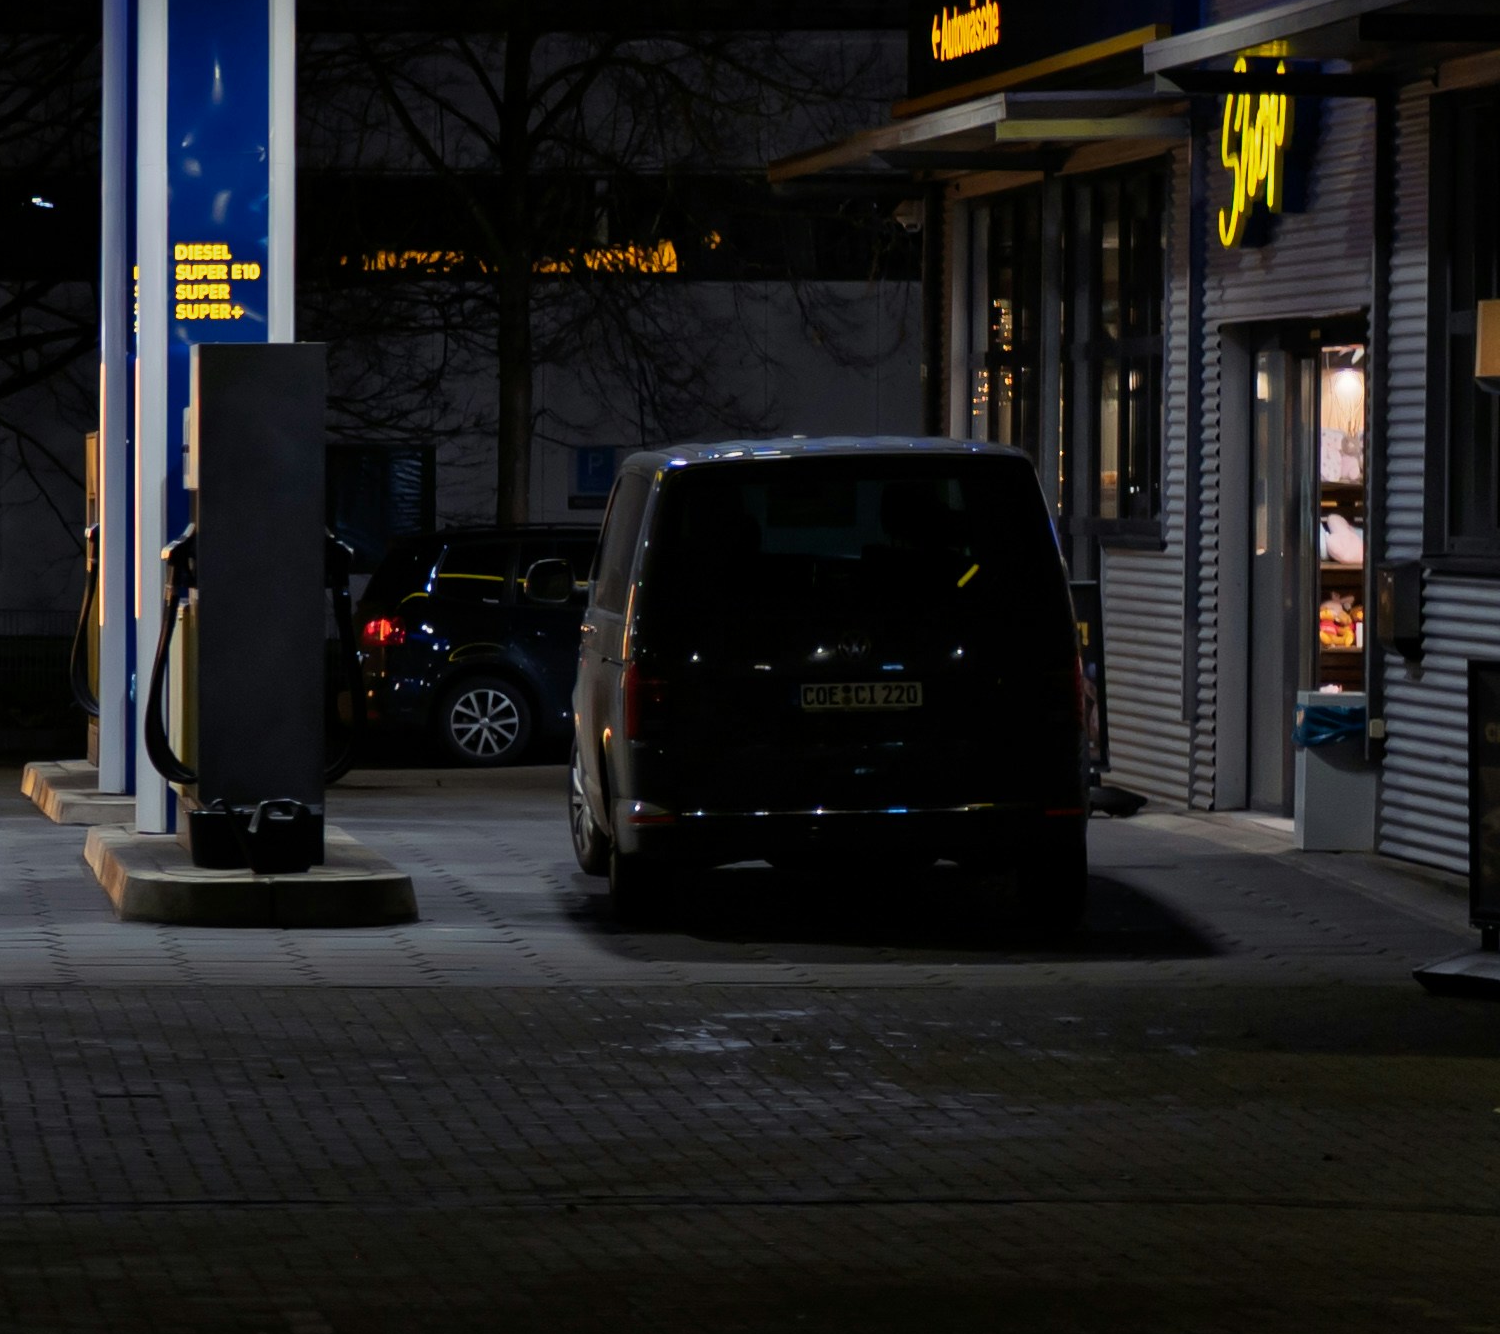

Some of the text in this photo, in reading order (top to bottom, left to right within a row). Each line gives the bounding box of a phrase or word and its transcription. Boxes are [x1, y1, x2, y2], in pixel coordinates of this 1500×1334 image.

[1218, 57, 1287, 247] Shop
[174, 244, 232, 261] DIESEL
[175, 263, 261, 280] SUPER E10
[175, 284, 231, 300] SUPER
[175, 303, 245, 320] SUPER+
[803, 685, 918, 705] COE CI 220
